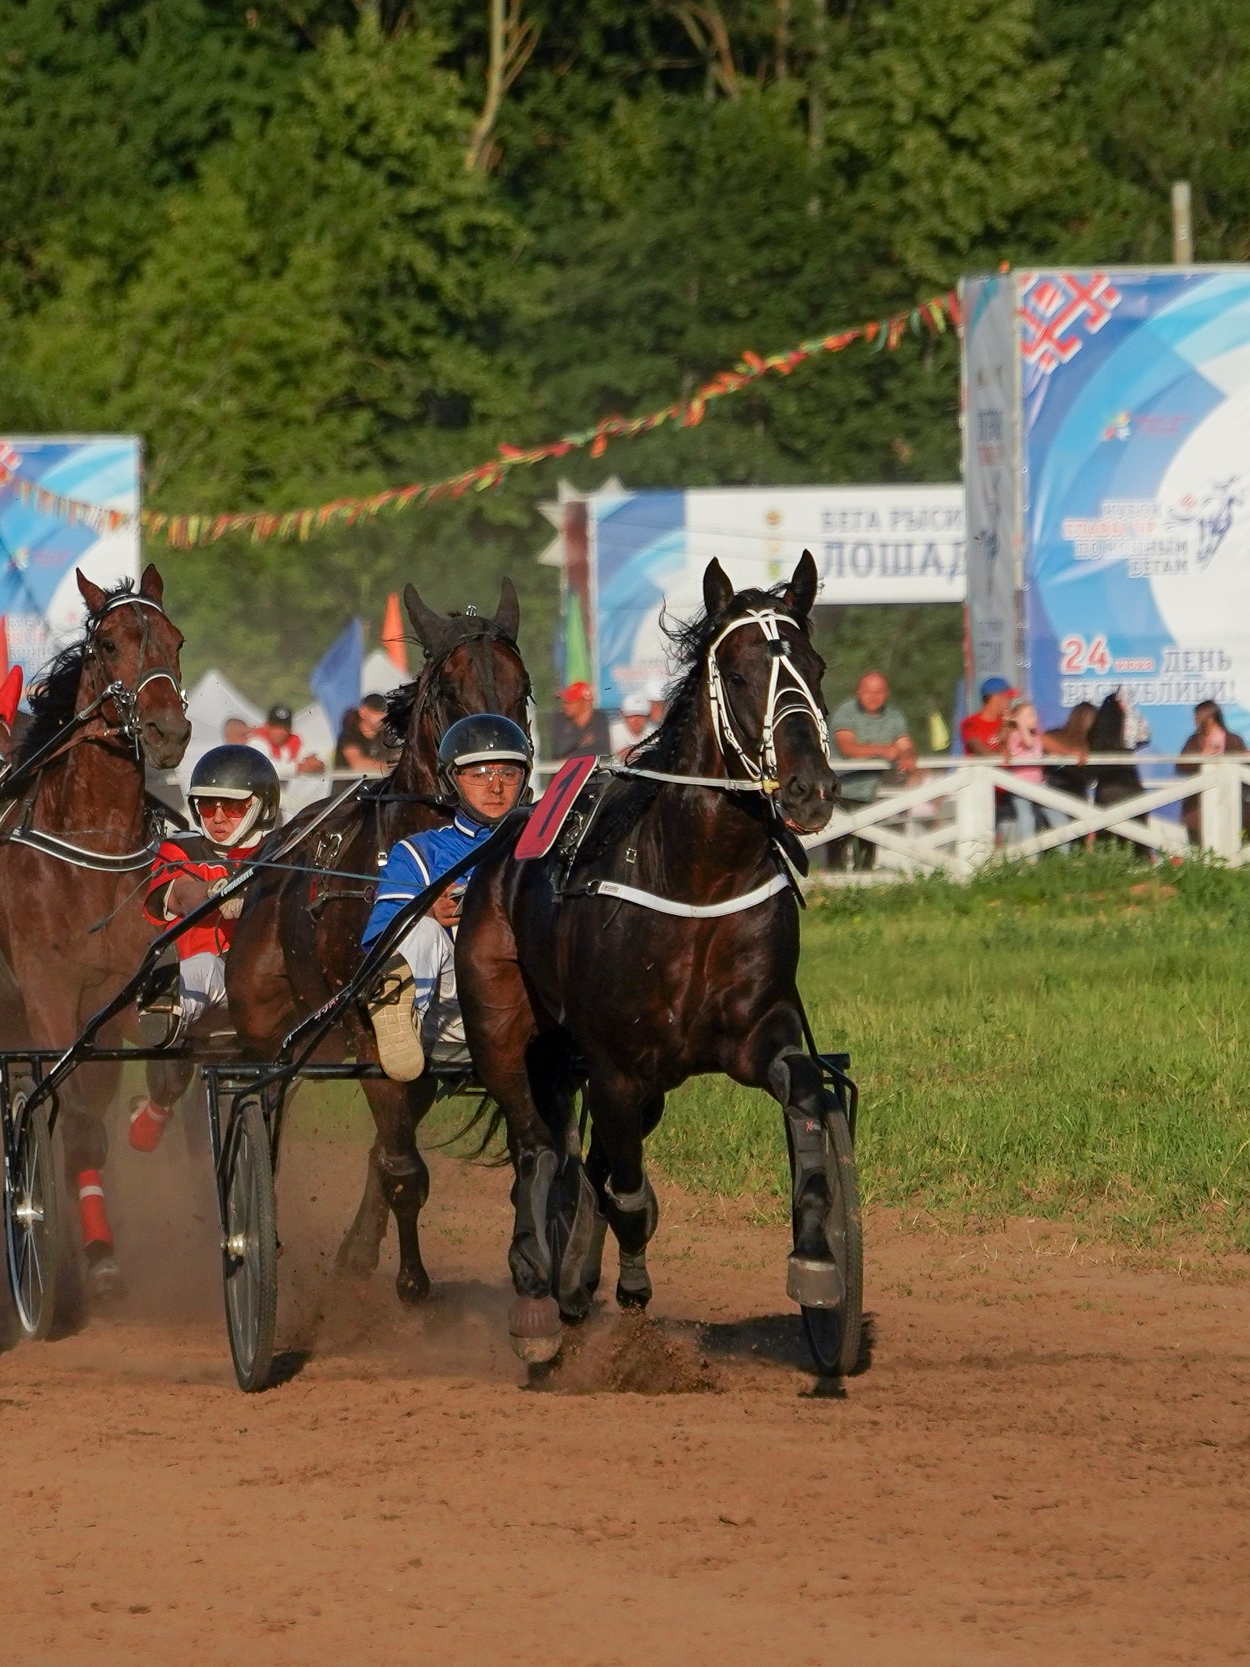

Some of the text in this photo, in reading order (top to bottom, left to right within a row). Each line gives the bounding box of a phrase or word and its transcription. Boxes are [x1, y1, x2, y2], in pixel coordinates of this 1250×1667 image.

[822, 510, 880, 532] БЕГА
[1063, 636, 1110, 673] 24
[1164, 650, 1233, 674] ДЕНЬ
[536, 760, 585, 838] 1
